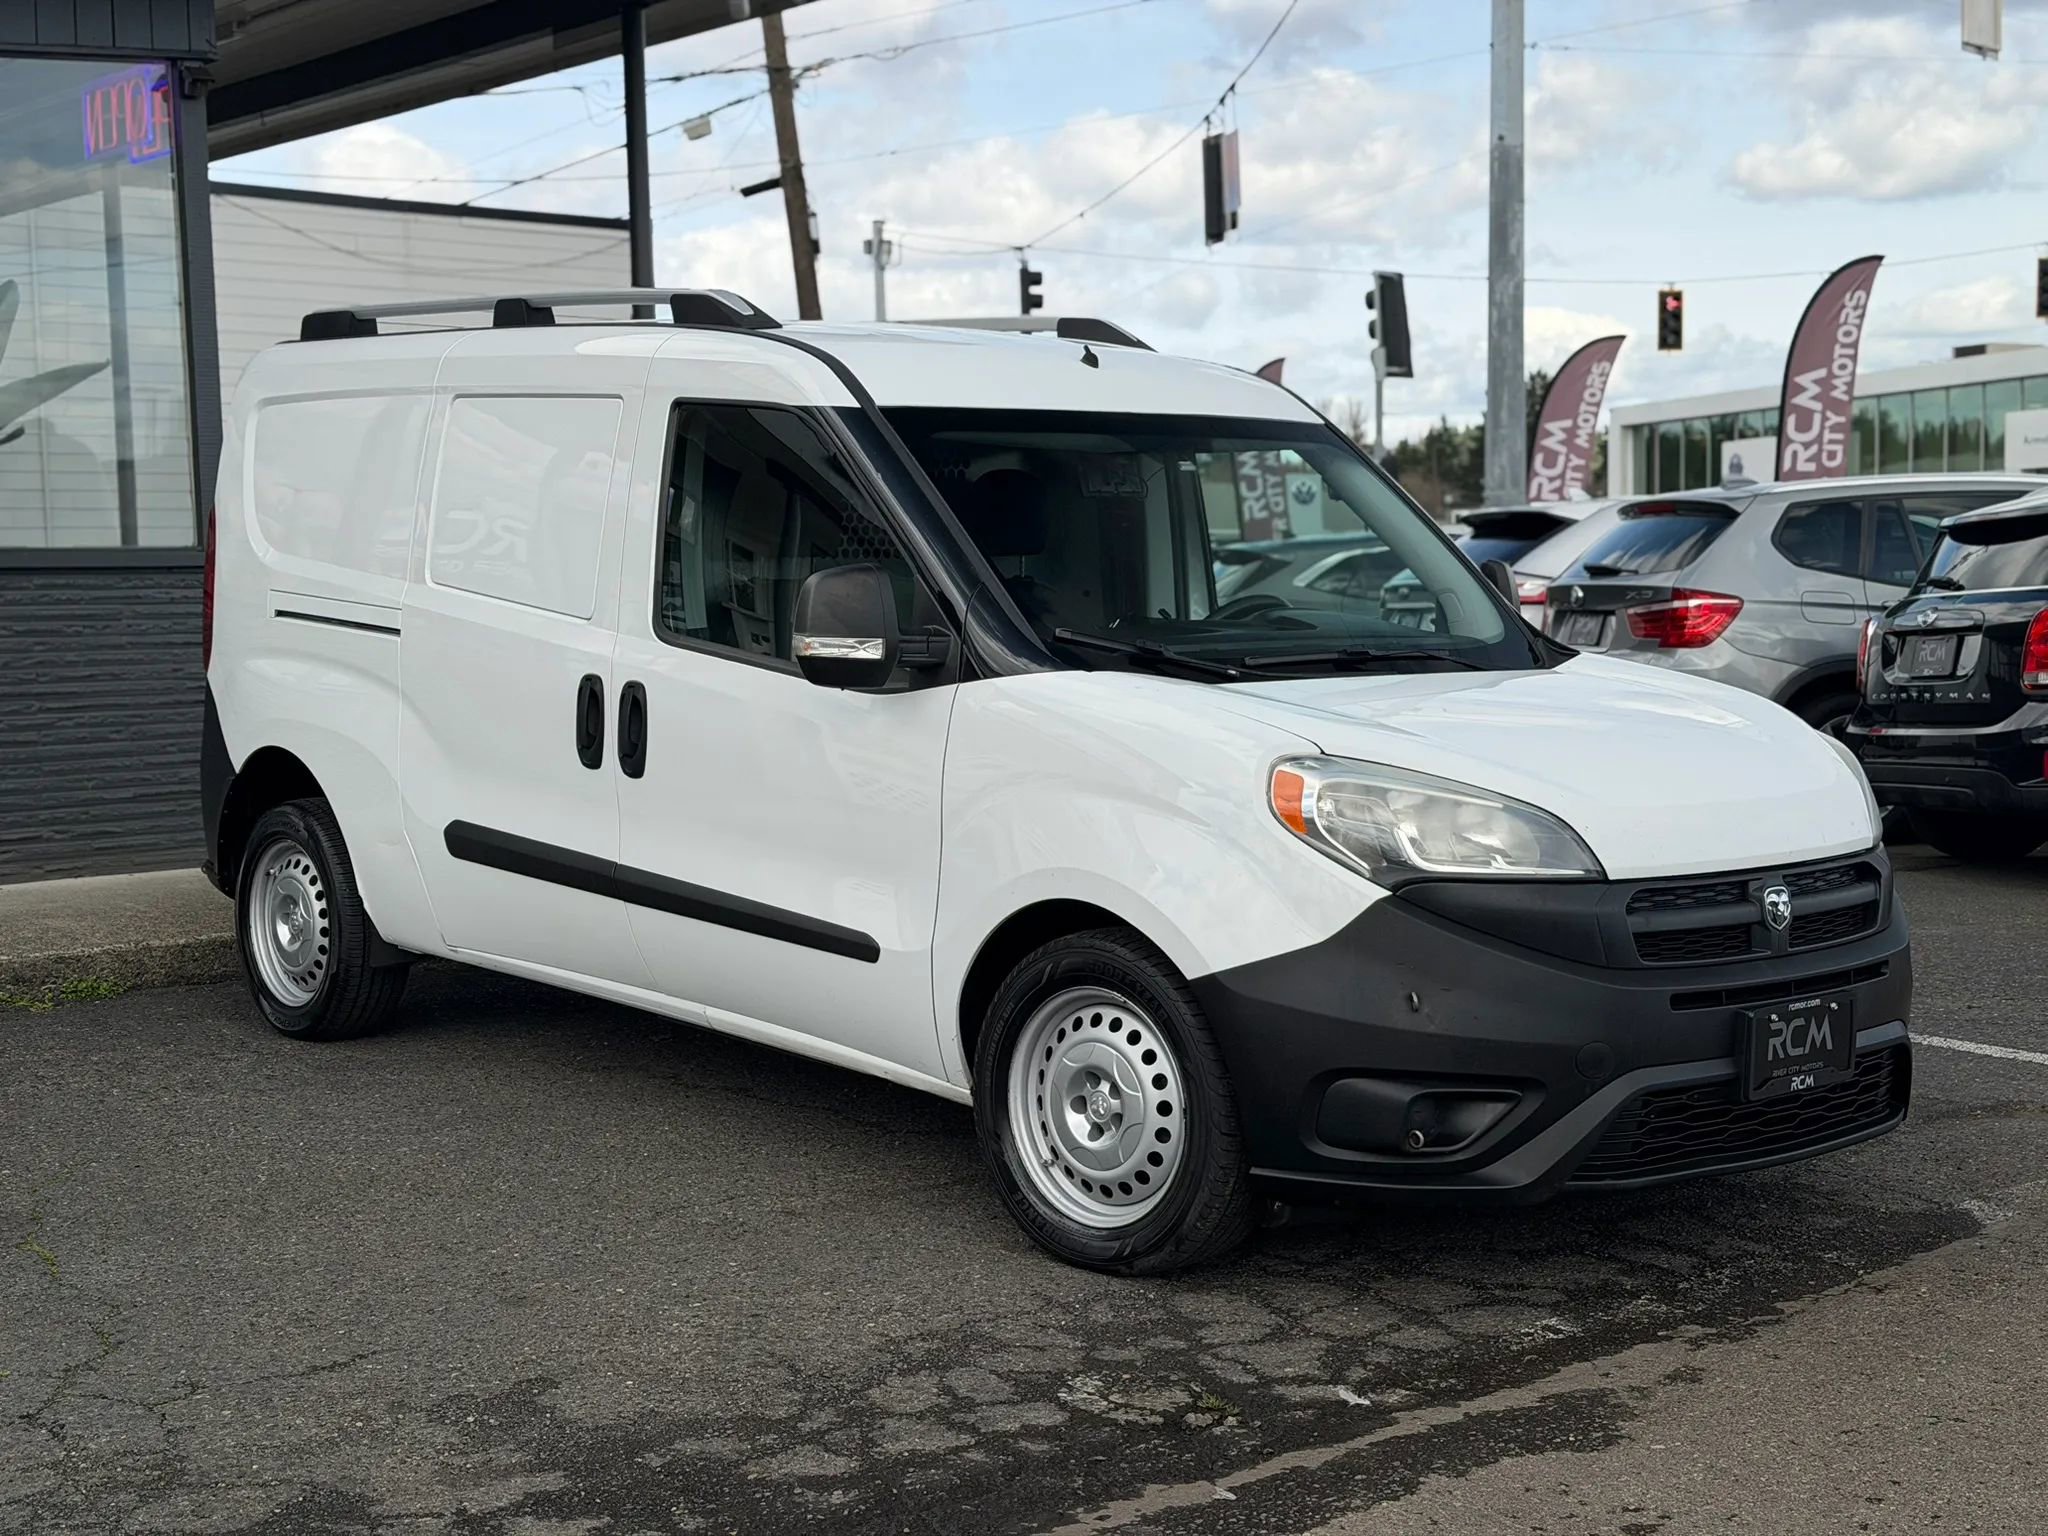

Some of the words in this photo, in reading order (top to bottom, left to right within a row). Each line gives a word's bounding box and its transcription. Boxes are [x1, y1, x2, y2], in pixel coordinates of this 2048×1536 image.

[1829, 289, 1867, 401] MOTORS
[1573, 361, 1611, 448] MOTORS
[1783, 367, 1828, 473] RCM
[1529, 418, 1574, 501] RCM
[1821, 411, 1846, 468] CITY
[1238, 451, 1269, 522] RCM
[1918, 643, 1946, 662] RCM
[1767, 1014, 1833, 1061] RCM
[1788, 1065, 1800, 1075] CITY
[1790, 1074, 1814, 1092] RCM
